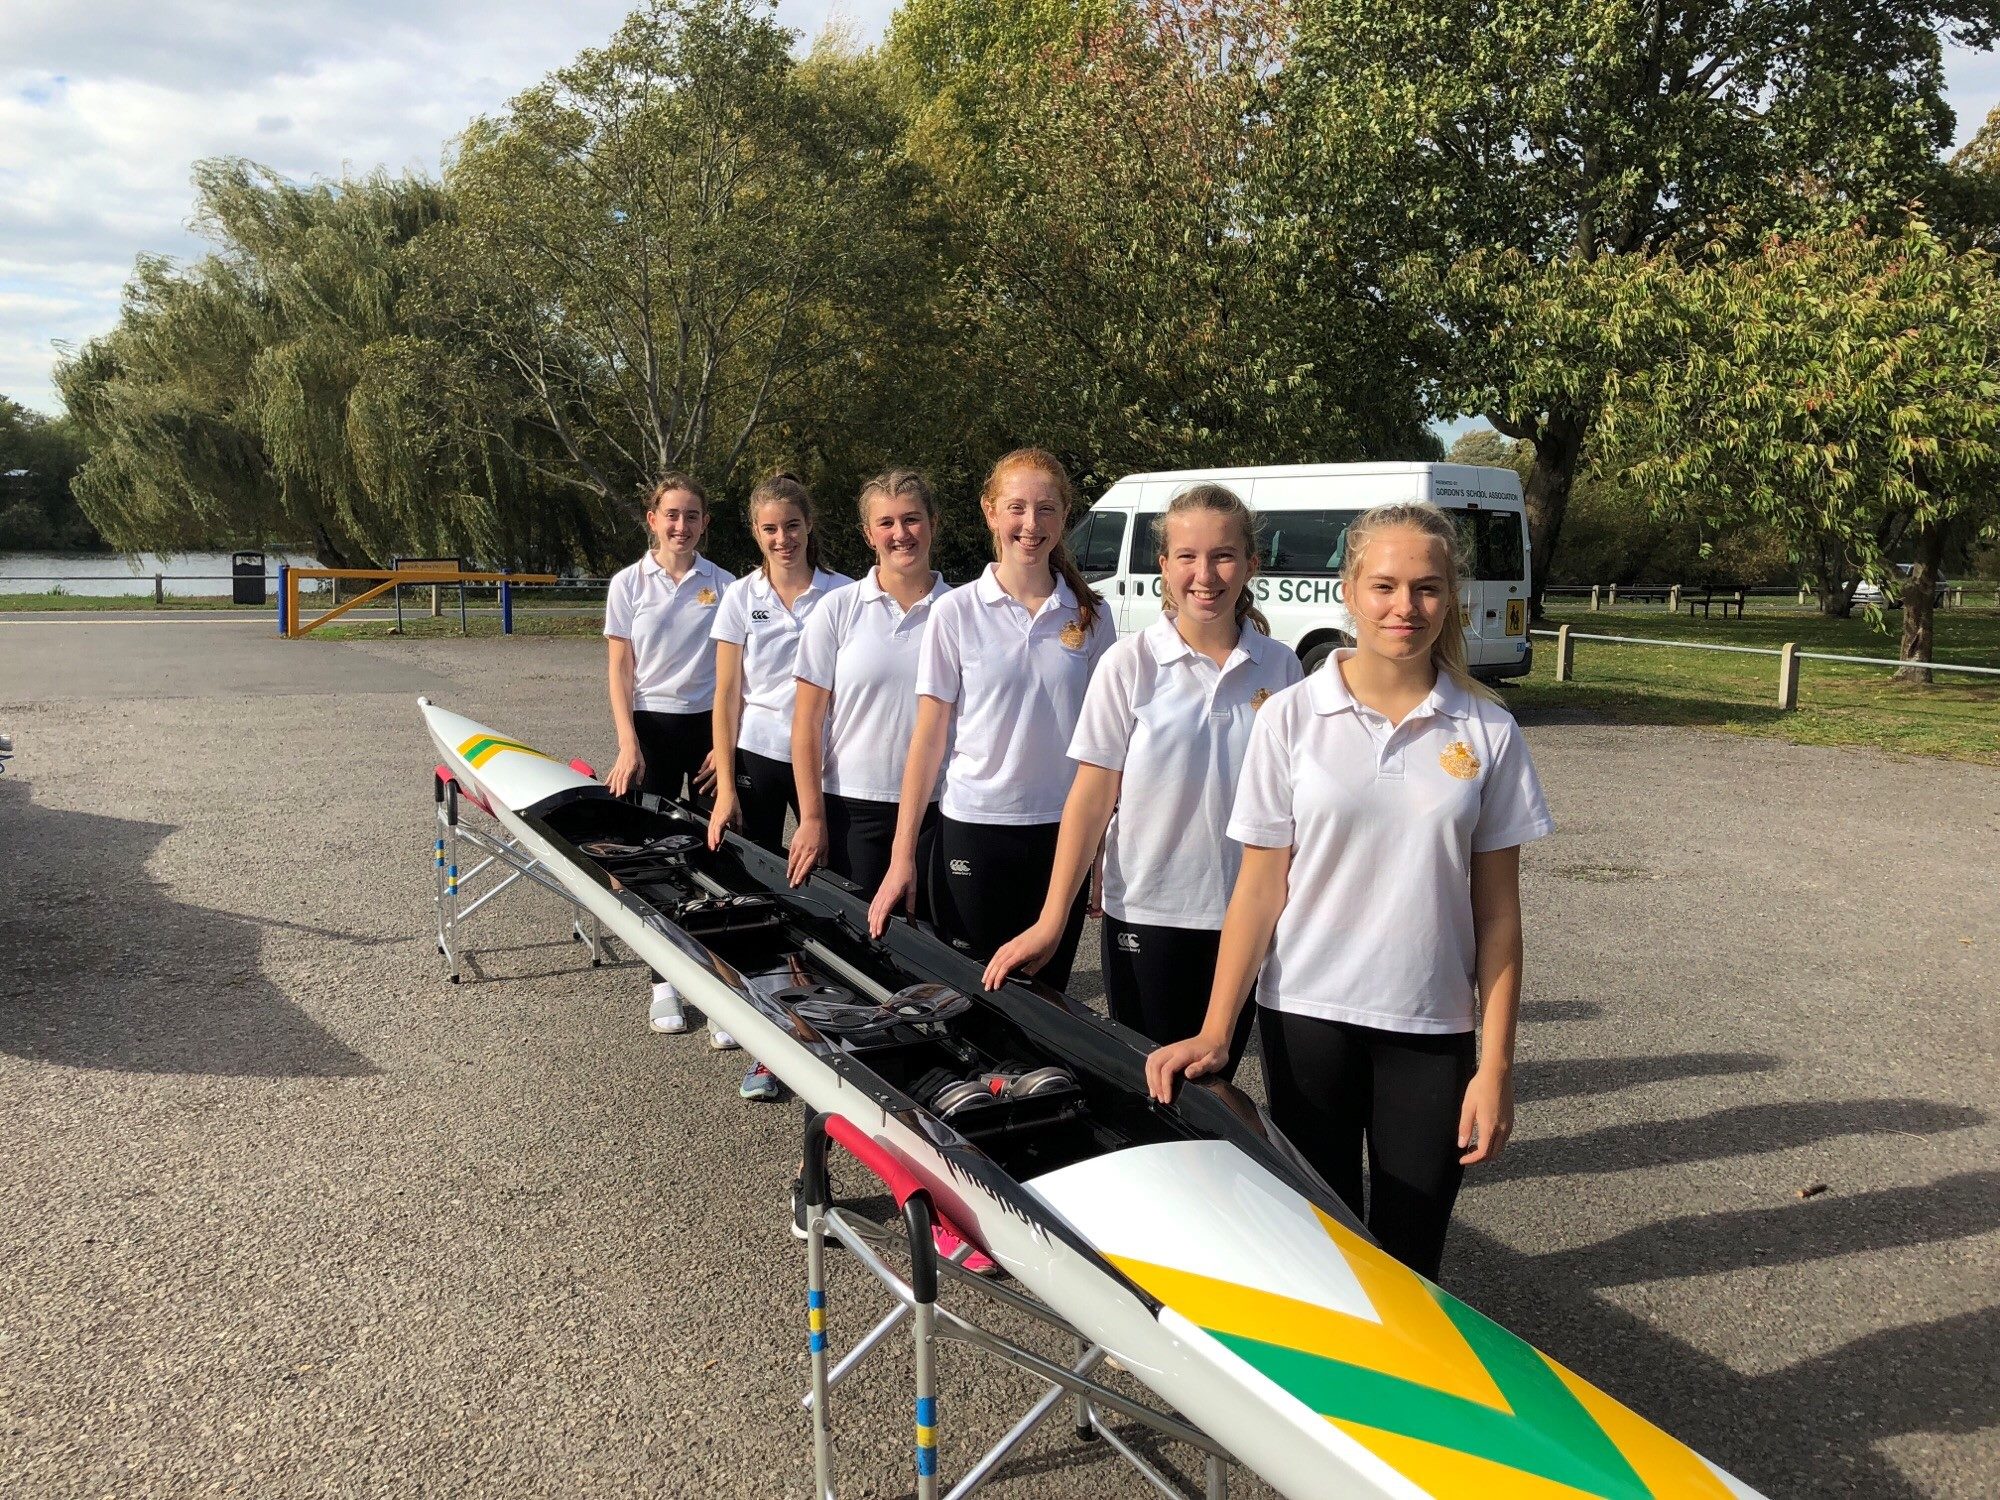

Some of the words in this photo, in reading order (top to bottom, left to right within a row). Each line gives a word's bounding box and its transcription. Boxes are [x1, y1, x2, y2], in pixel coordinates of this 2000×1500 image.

[1436, 487, 1465, 497] GORDON'S
[1466, 489, 1488, 499] SCHOOL
[1488, 491, 1519, 501] ASSOCIATION
[1278, 579, 1344, 604] SCHO
